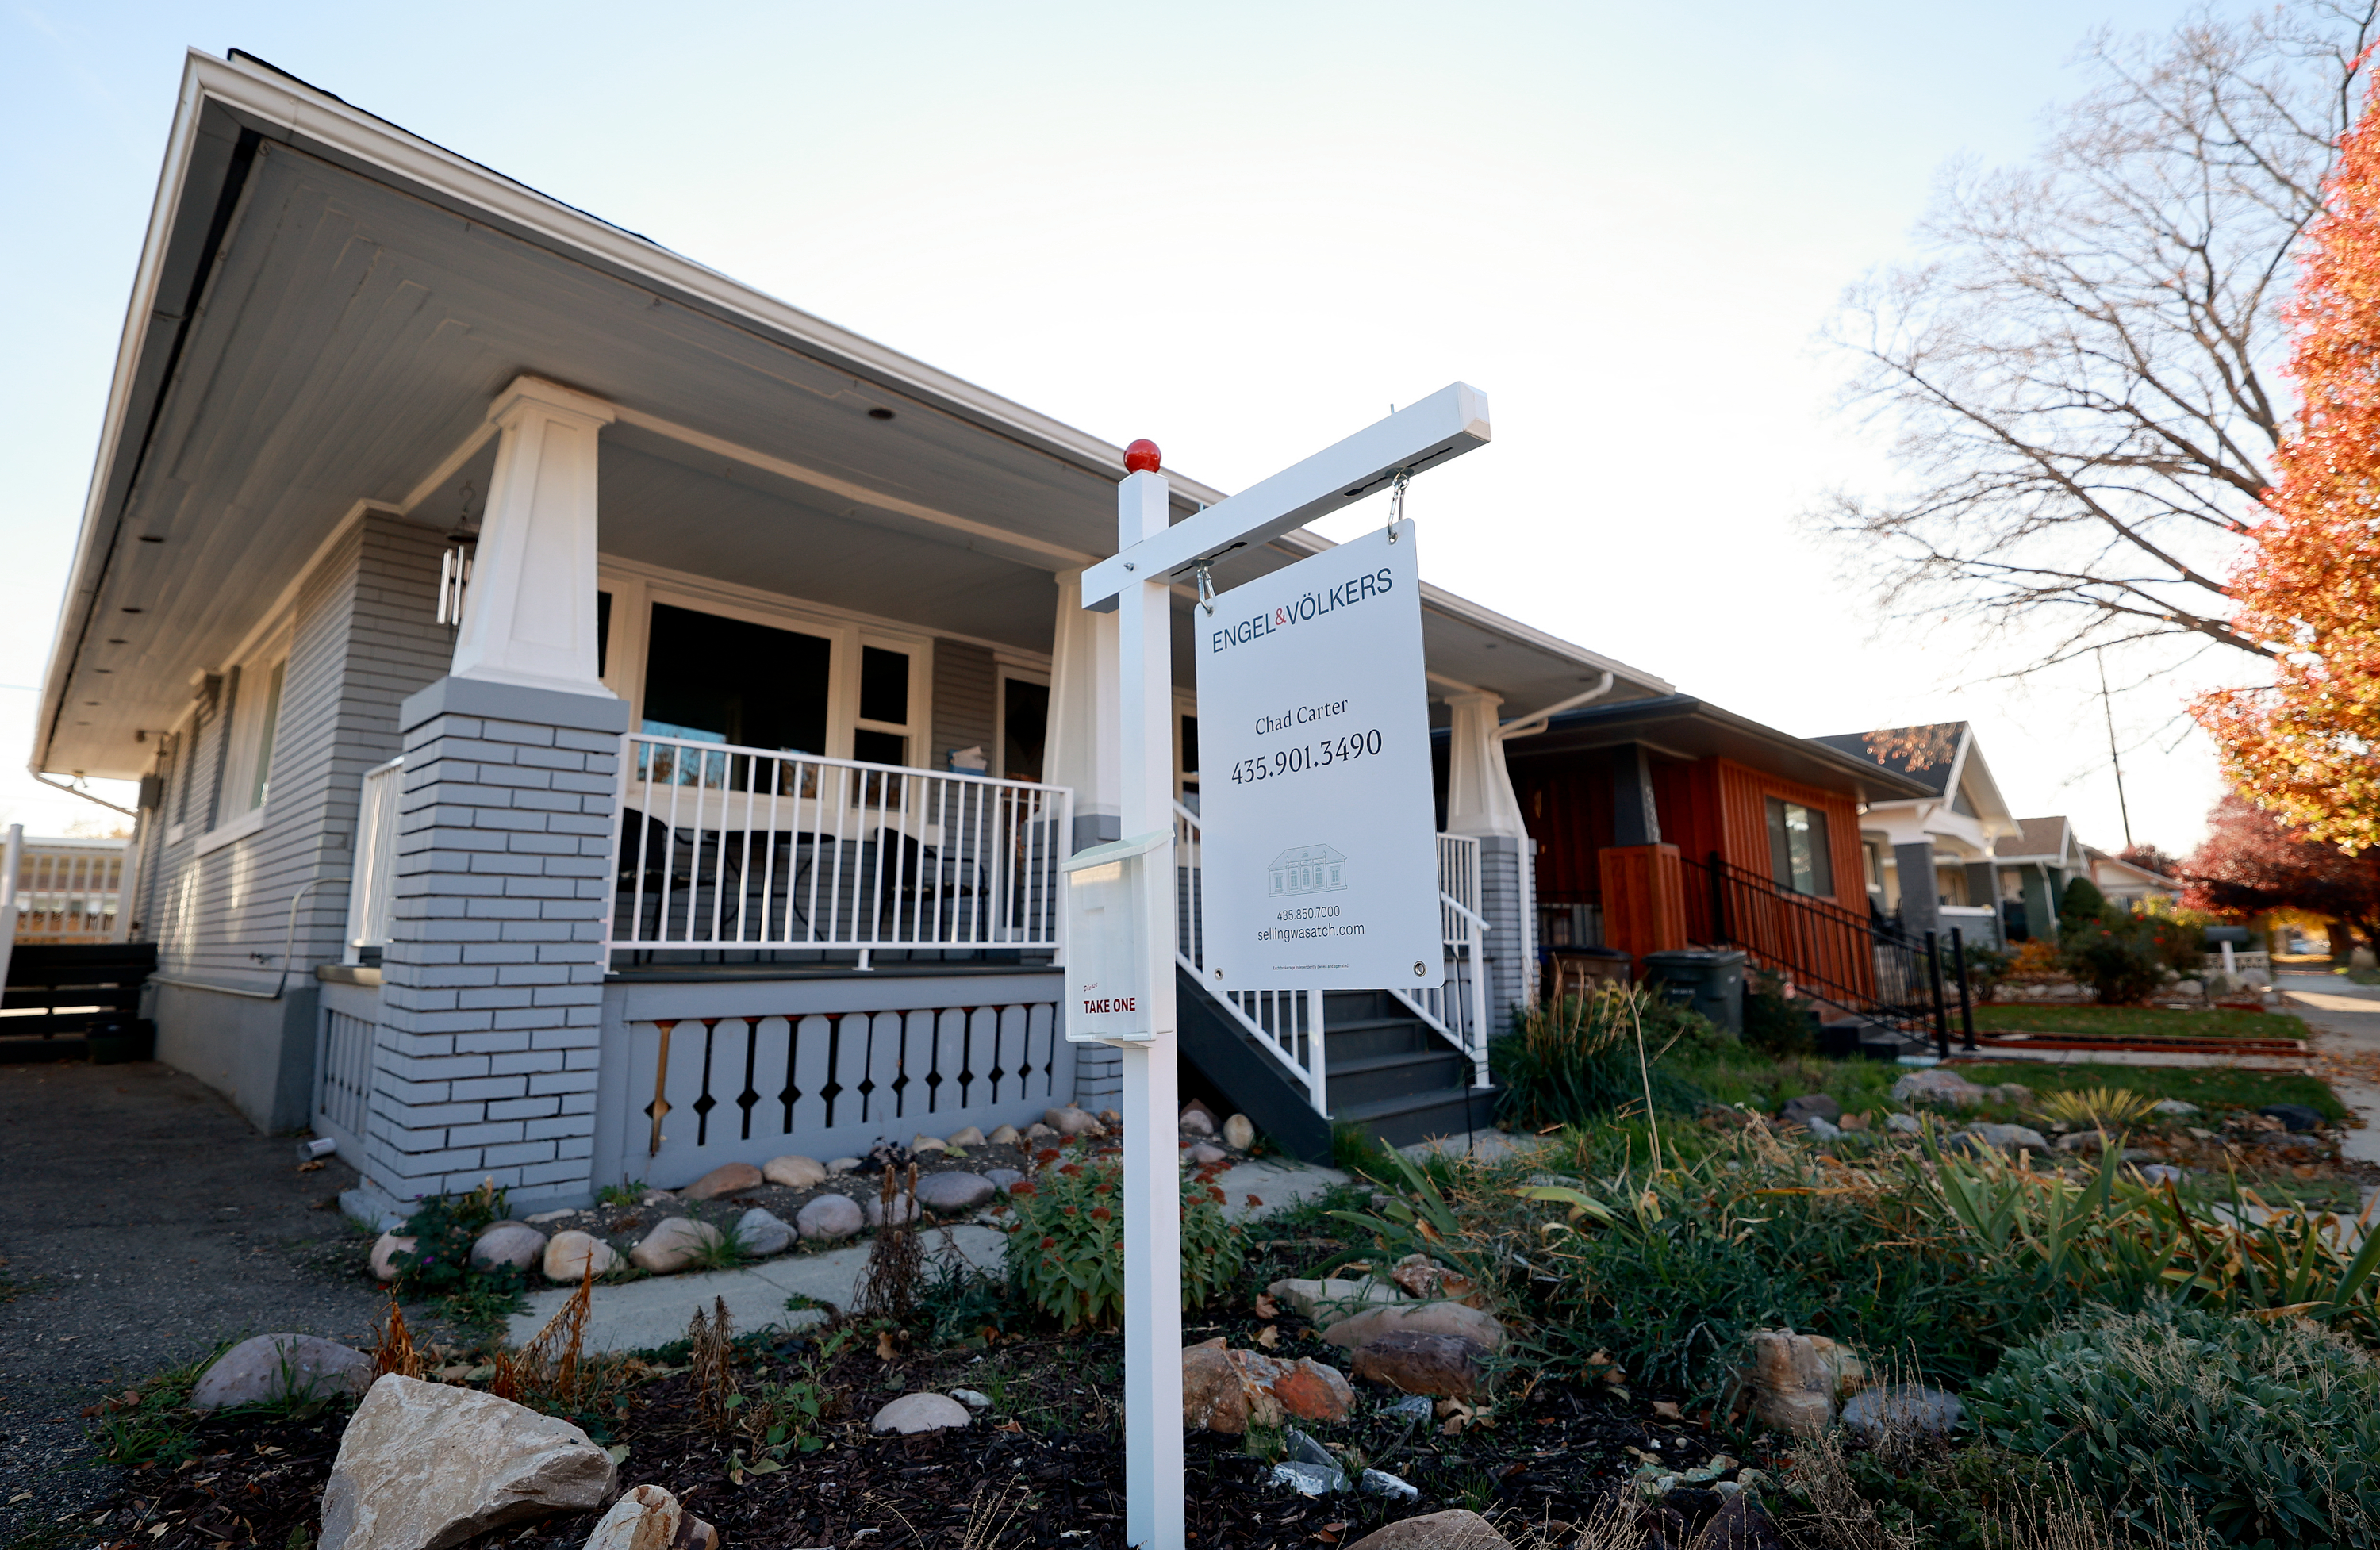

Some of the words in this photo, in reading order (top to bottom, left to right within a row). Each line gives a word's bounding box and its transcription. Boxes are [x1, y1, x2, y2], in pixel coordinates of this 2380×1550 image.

[1212, 567, 1393, 654] ENGEL&VÖLKERS
[1255, 710, 1292, 735] Chad
[1296, 699, 1349, 724] Carter
[1231, 728, 1383, 785] 435.901.3490
[1277, 905, 1341, 921] 435.850.7000
[1257, 923, 1365, 943] sellingwasatch.com
[1083, 982, 1098, 994] Please
[1084, 999, 1111, 1014] TAKE
[1113, 997, 1136, 1013] ONE
